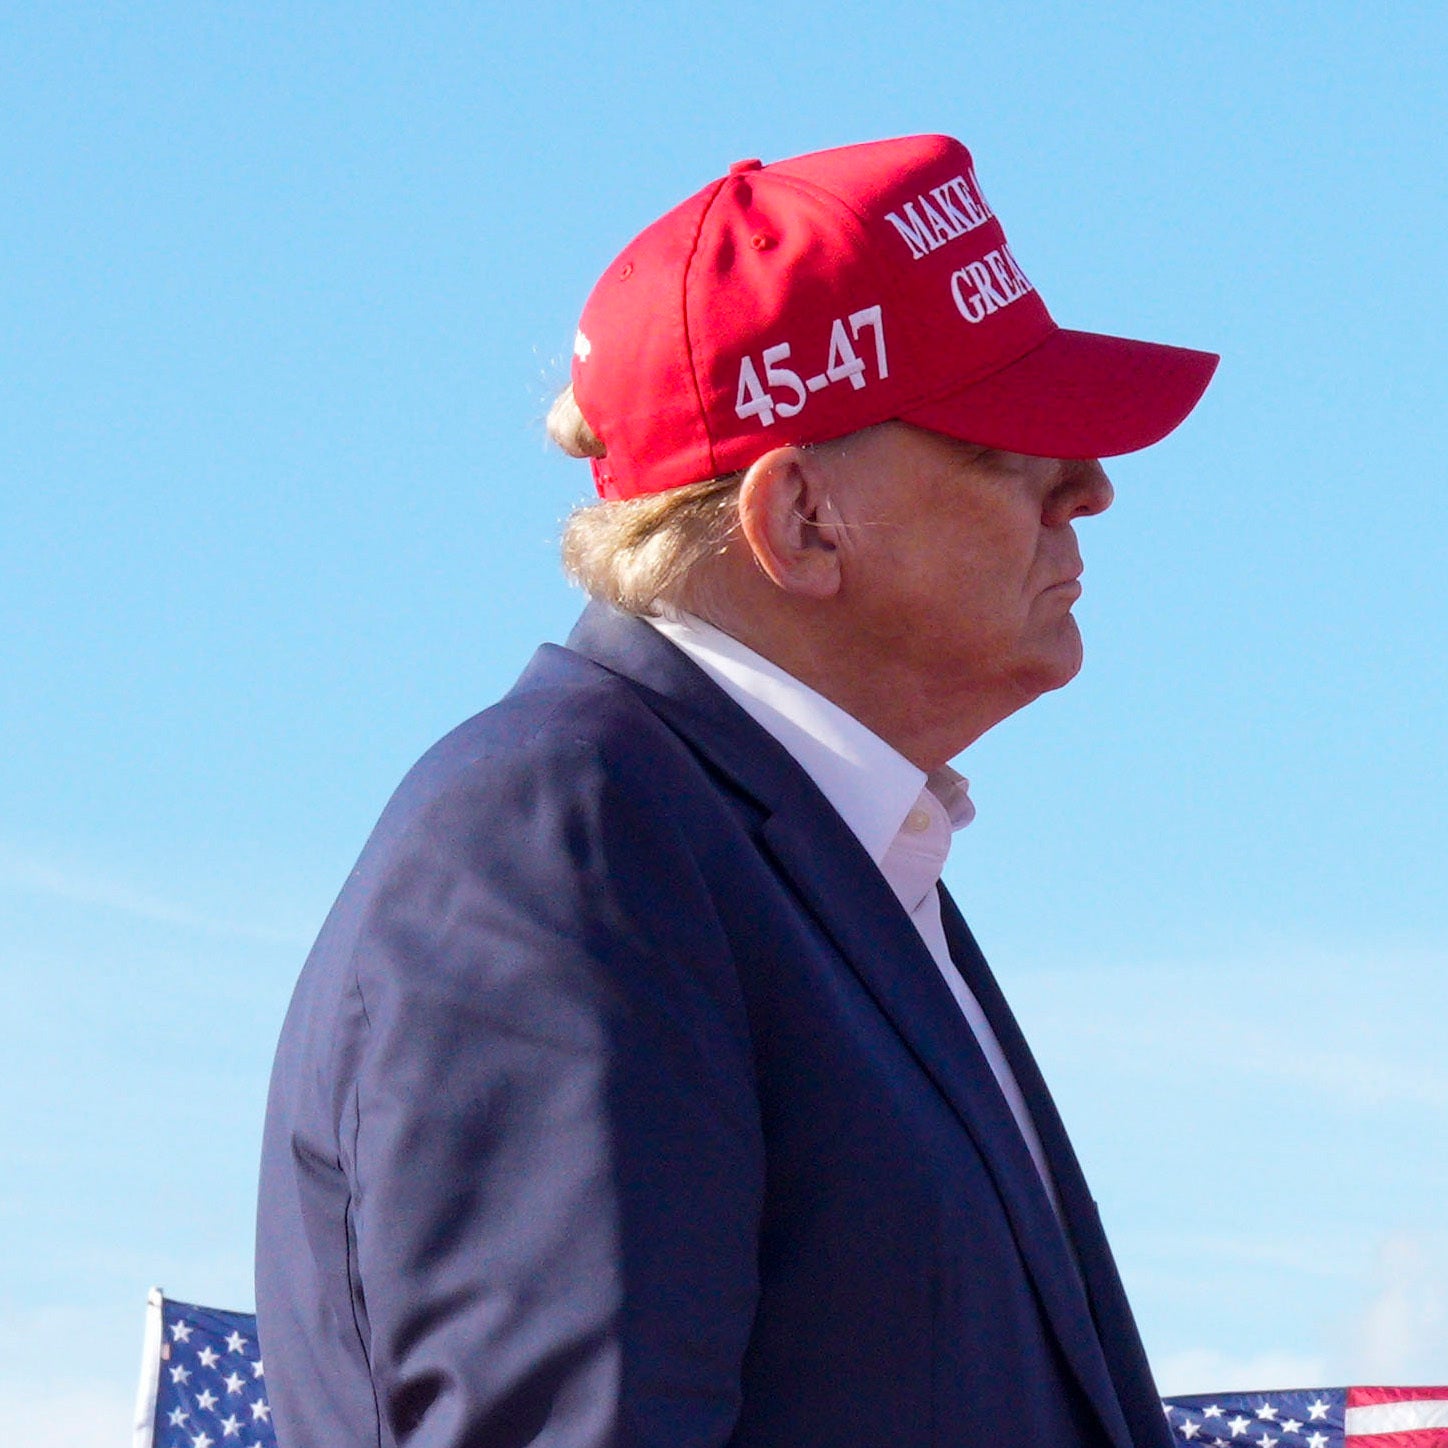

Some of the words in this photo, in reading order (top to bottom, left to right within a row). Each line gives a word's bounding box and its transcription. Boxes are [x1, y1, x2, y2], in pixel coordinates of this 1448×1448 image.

[884, 174, 989, 261] MAKE
[950, 244, 1034, 324] GREA
[734, 304, 891, 427] 45-47
